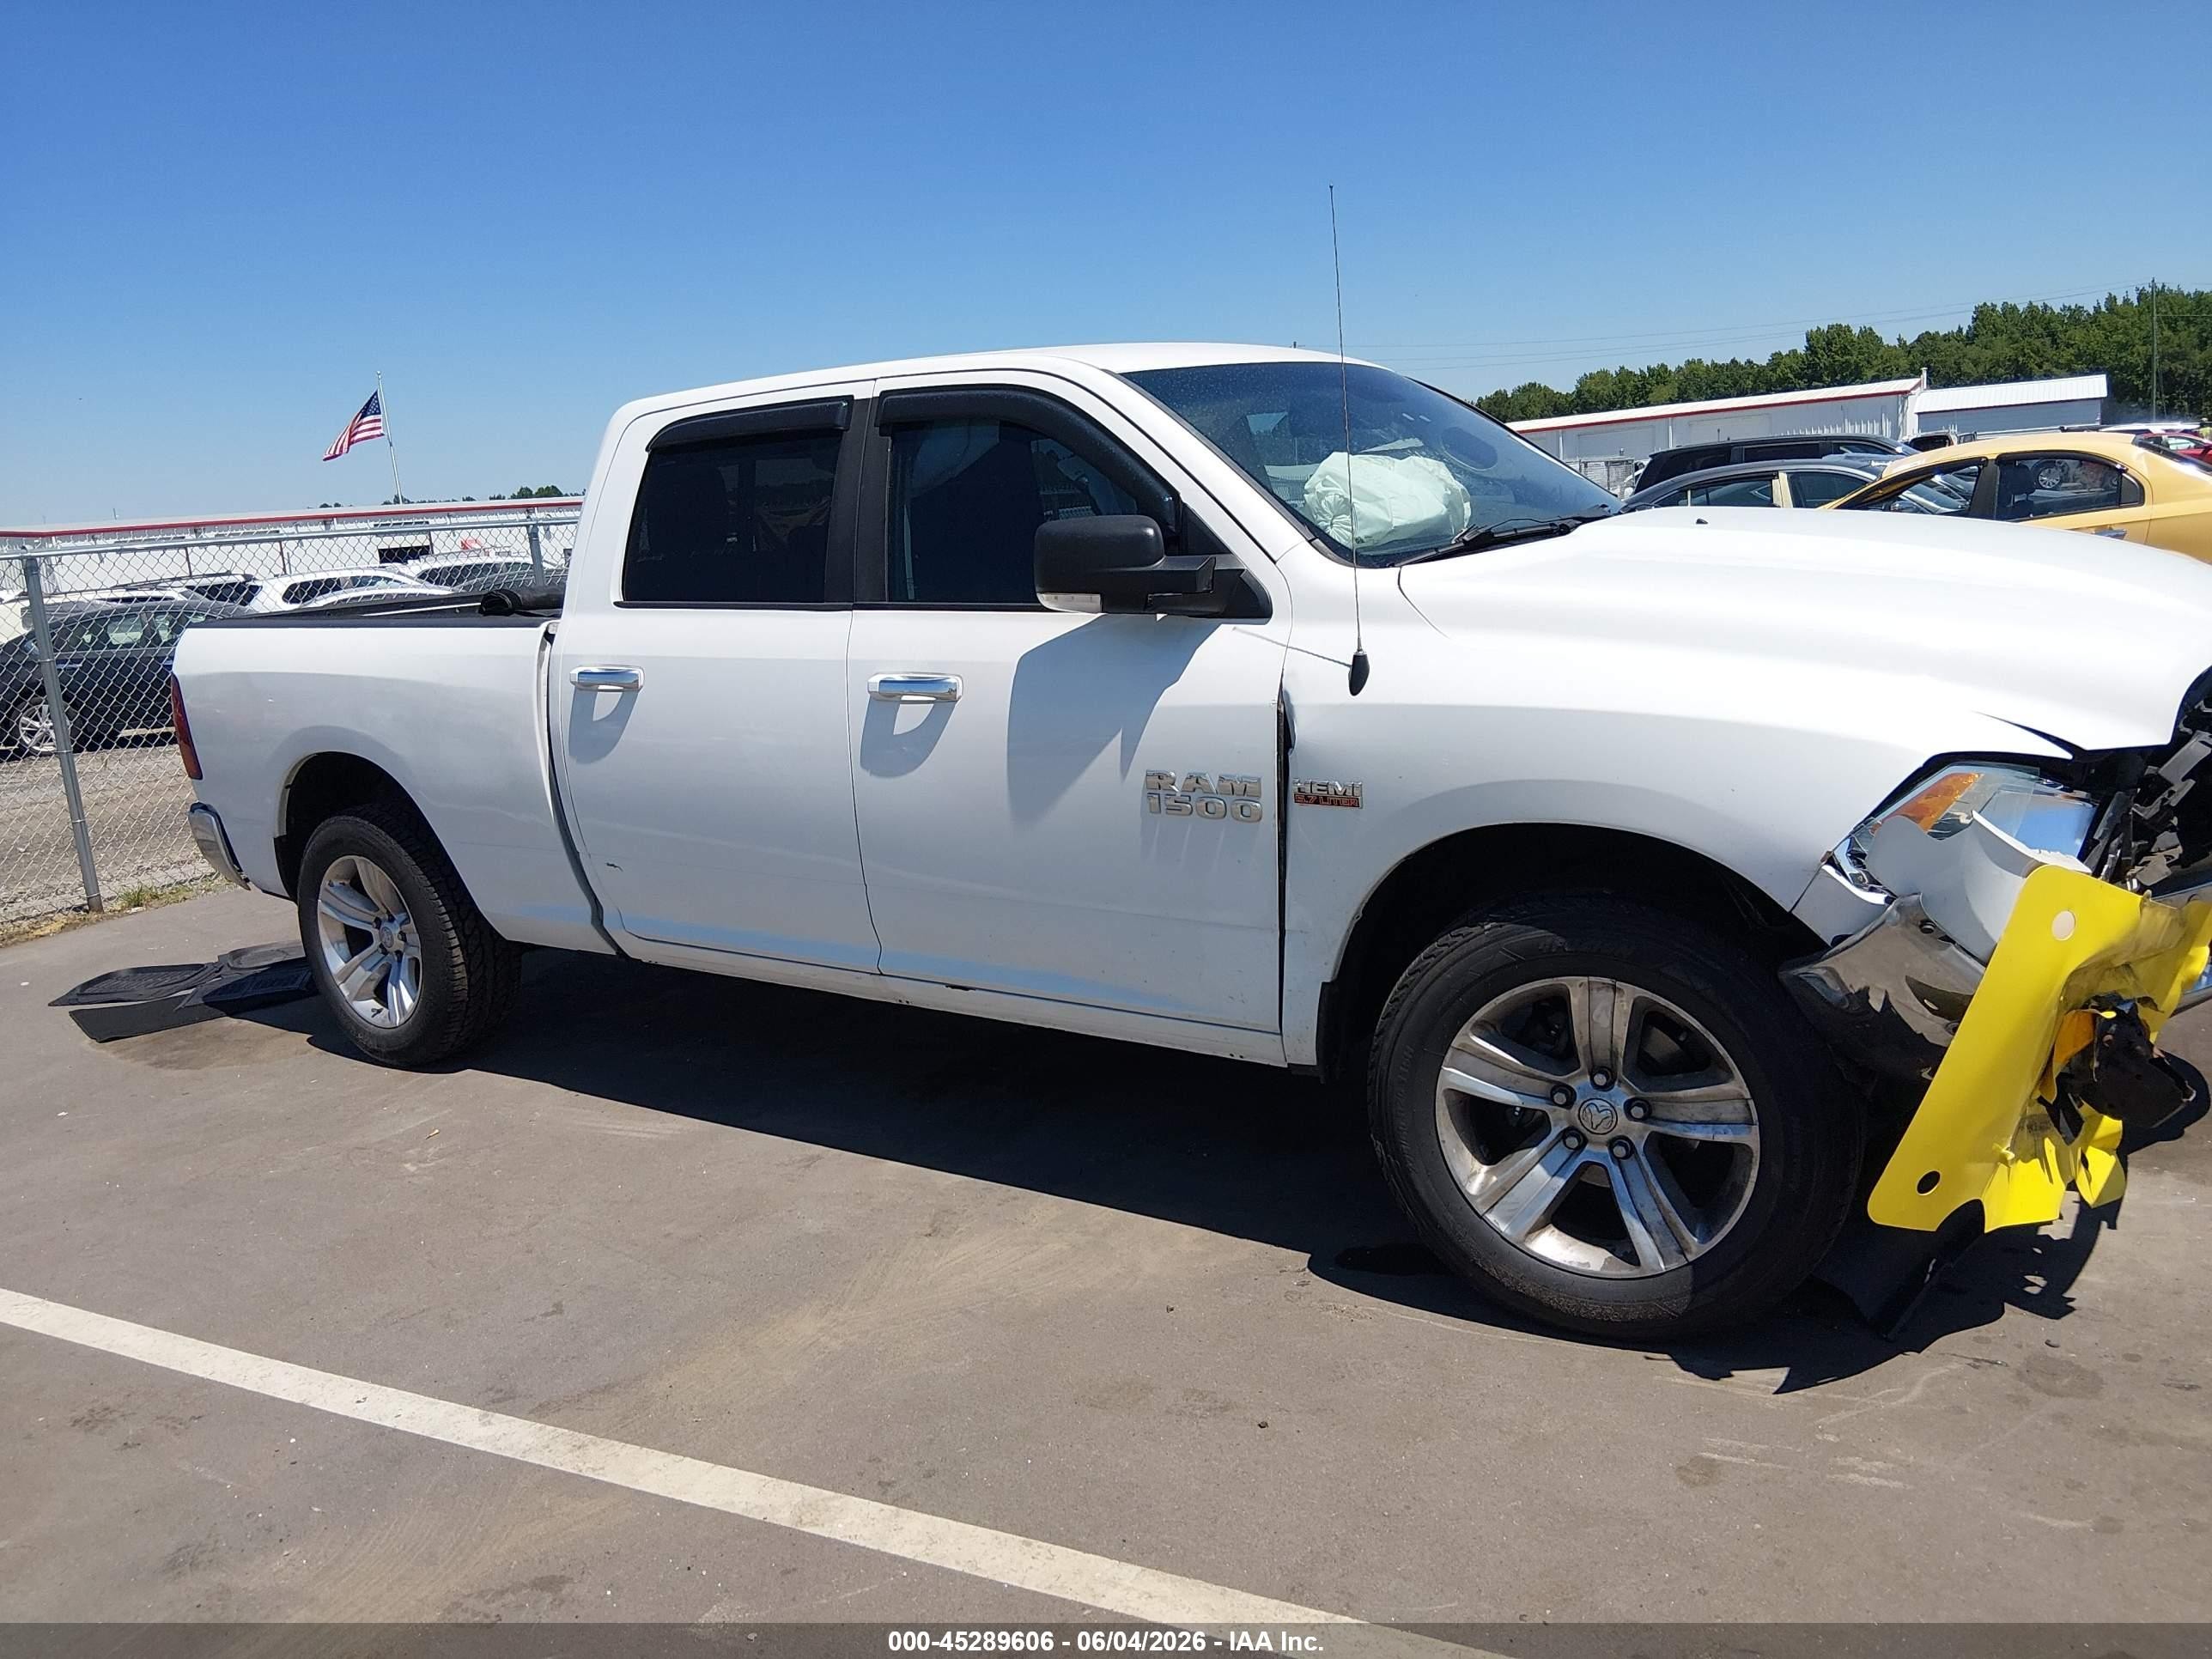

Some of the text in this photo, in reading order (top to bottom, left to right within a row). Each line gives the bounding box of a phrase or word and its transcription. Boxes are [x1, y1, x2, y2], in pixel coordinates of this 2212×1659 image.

[1146, 770, 1261, 797] RAM
[1292, 778, 1362, 797] HEMI
[1147, 793, 1262, 823] 1500
[1295, 794, 1358, 807] 5.7 LITER
